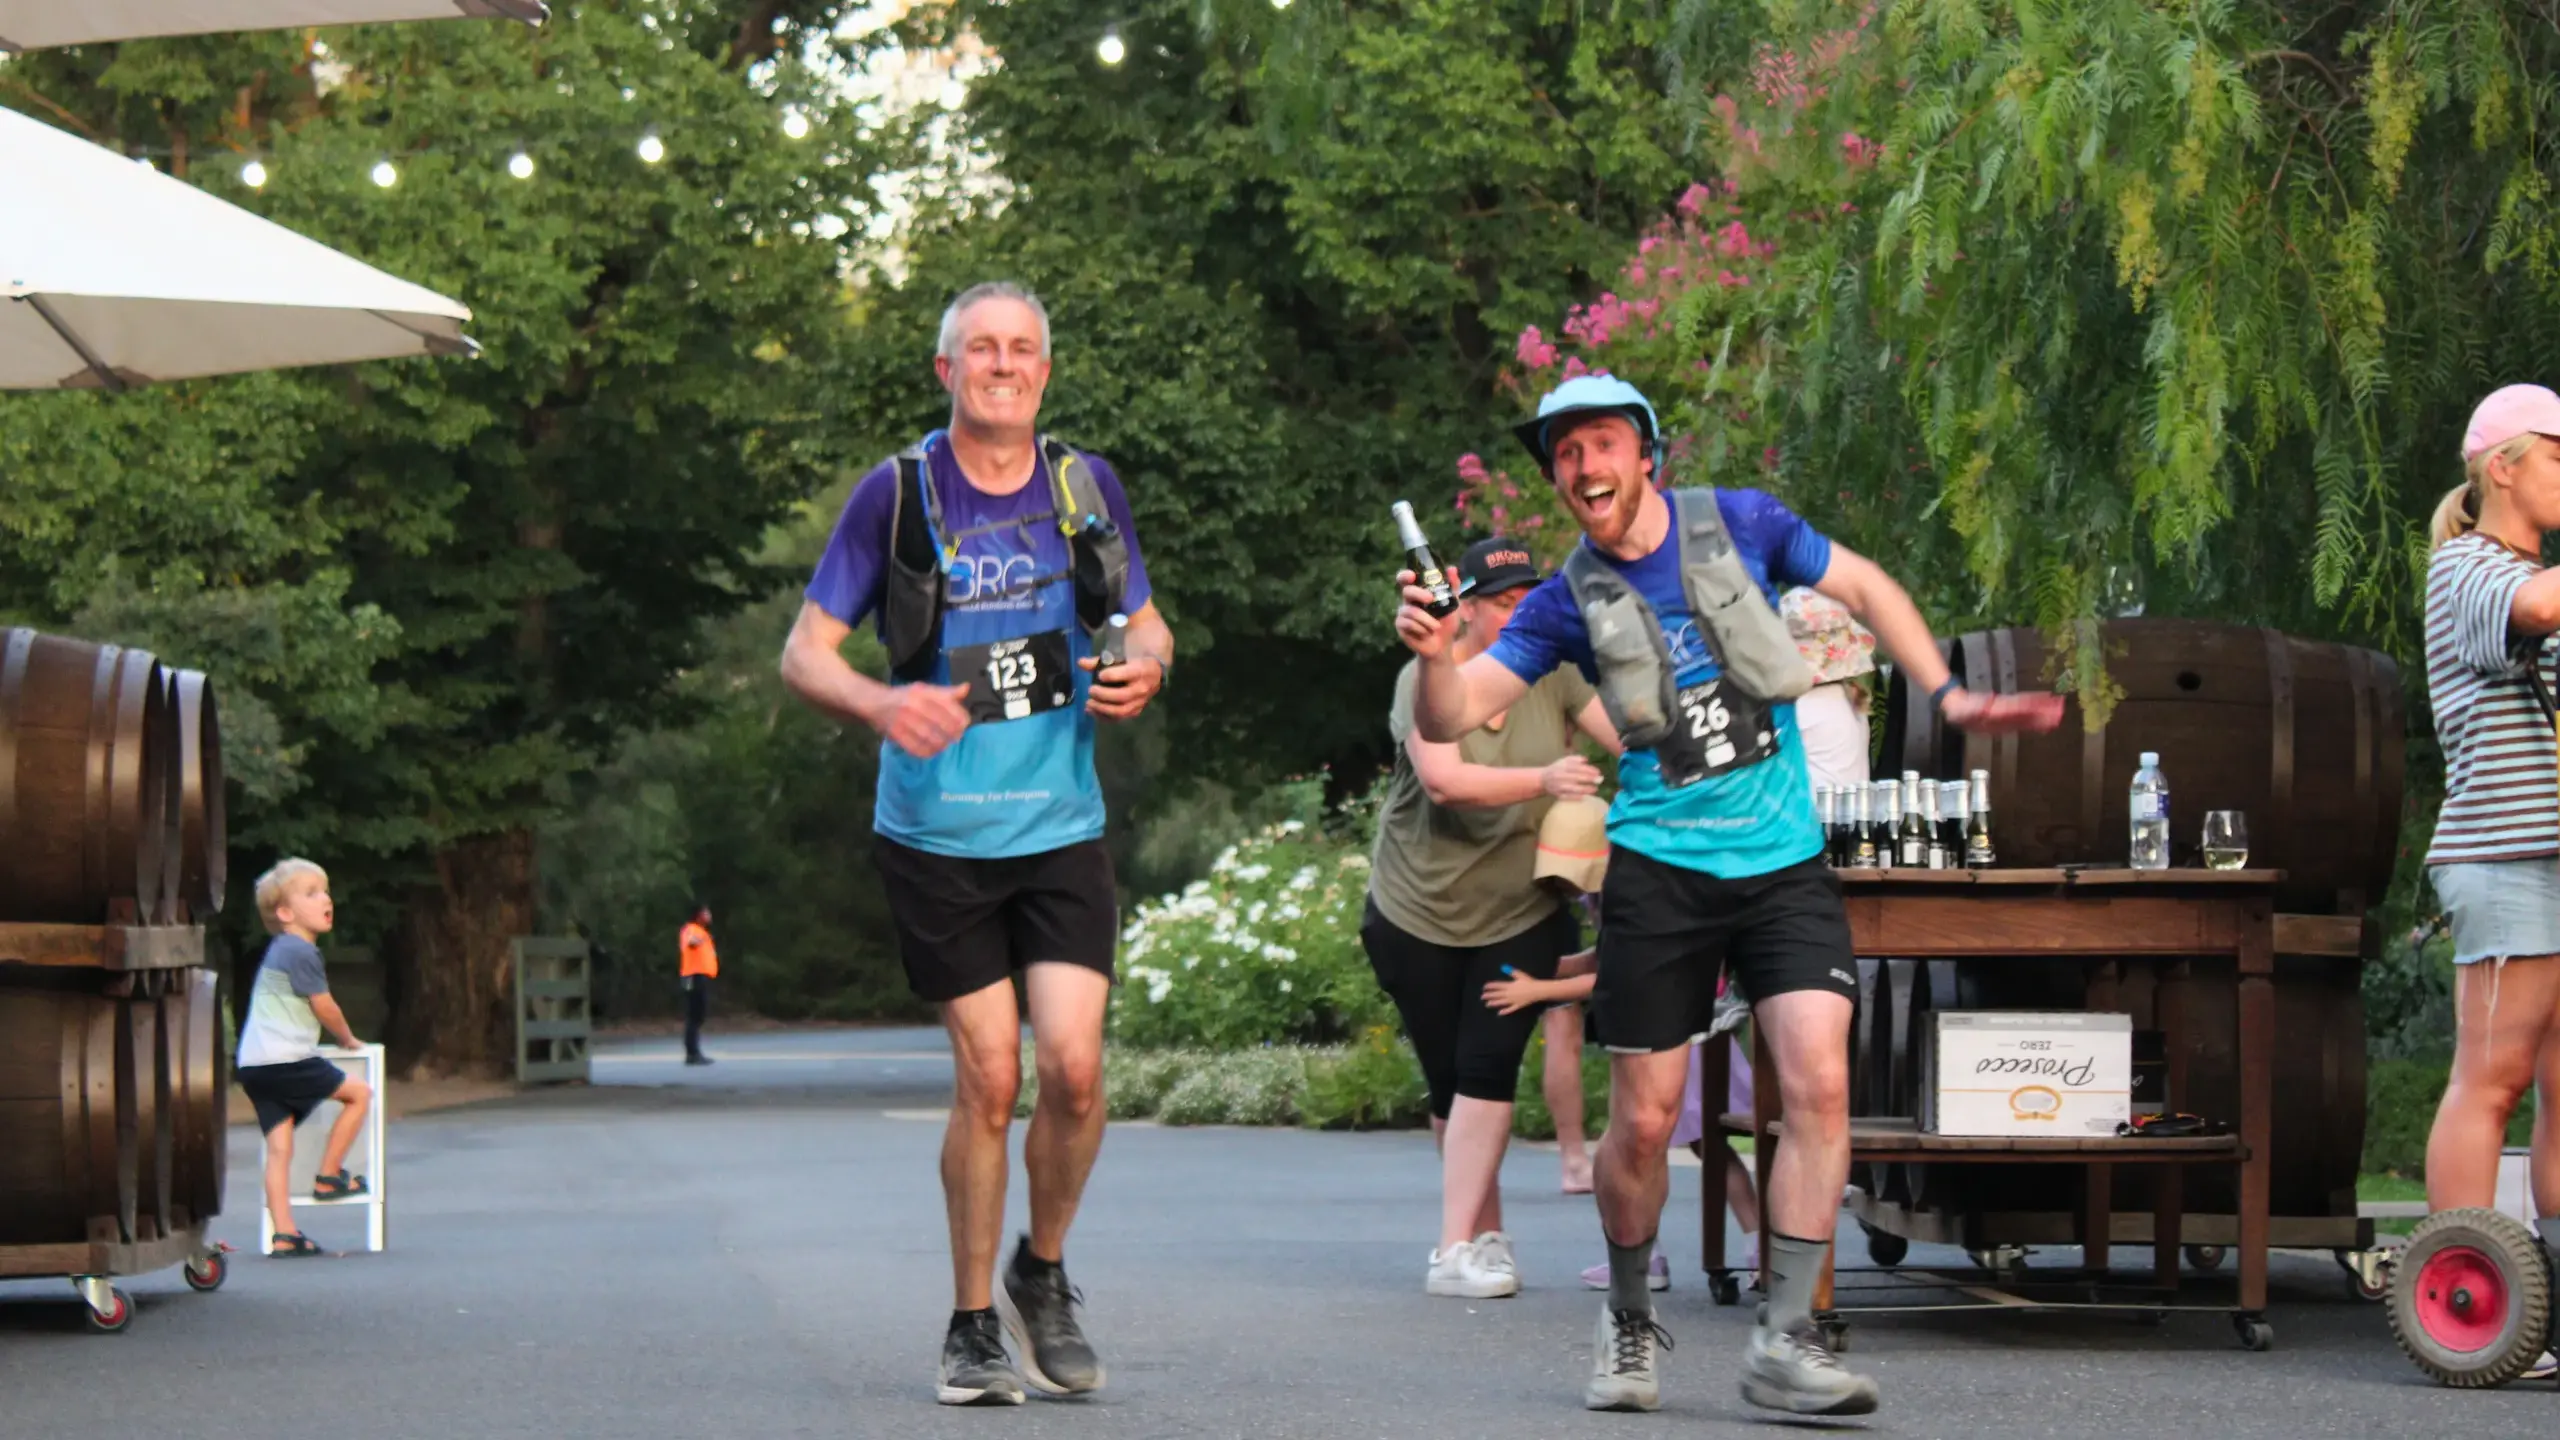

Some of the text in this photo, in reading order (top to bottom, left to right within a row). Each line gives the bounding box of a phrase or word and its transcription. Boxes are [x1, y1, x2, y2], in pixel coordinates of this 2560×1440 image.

[1485, 549, 1529, 566] BROWN
[987, 653, 1037, 691] 123
[1685, 697, 1730, 739] 26
[2020, 1040, 2053, 1050] ZERO
[1976, 1056, 2095, 1086] Prosecco
